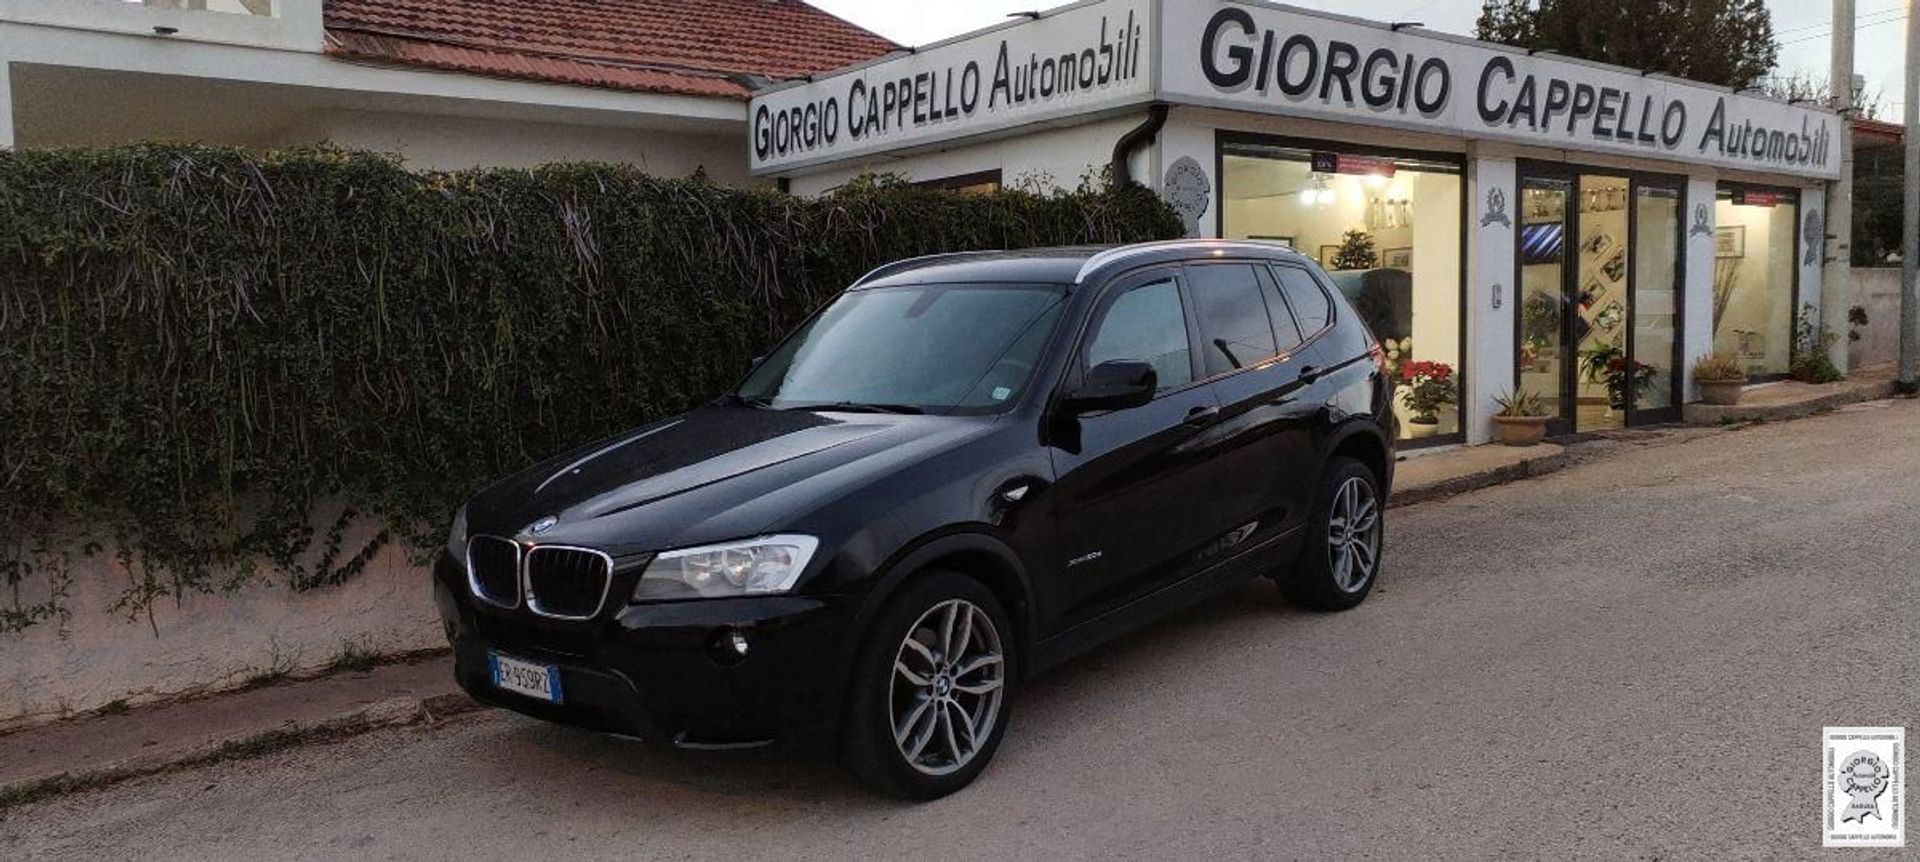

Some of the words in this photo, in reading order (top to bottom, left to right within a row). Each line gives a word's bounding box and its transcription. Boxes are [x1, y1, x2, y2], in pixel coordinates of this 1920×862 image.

[755, 97, 839, 160] GIORGIO
[848, 60, 980, 138] CAPPELLO
[988, 9, 1141, 108] Automobili
[1200, 7, 1451, 115] GIORGIO
[1477, 56, 1688, 147] CAPPELLO
[1699, 97, 1830, 166] Automobili
